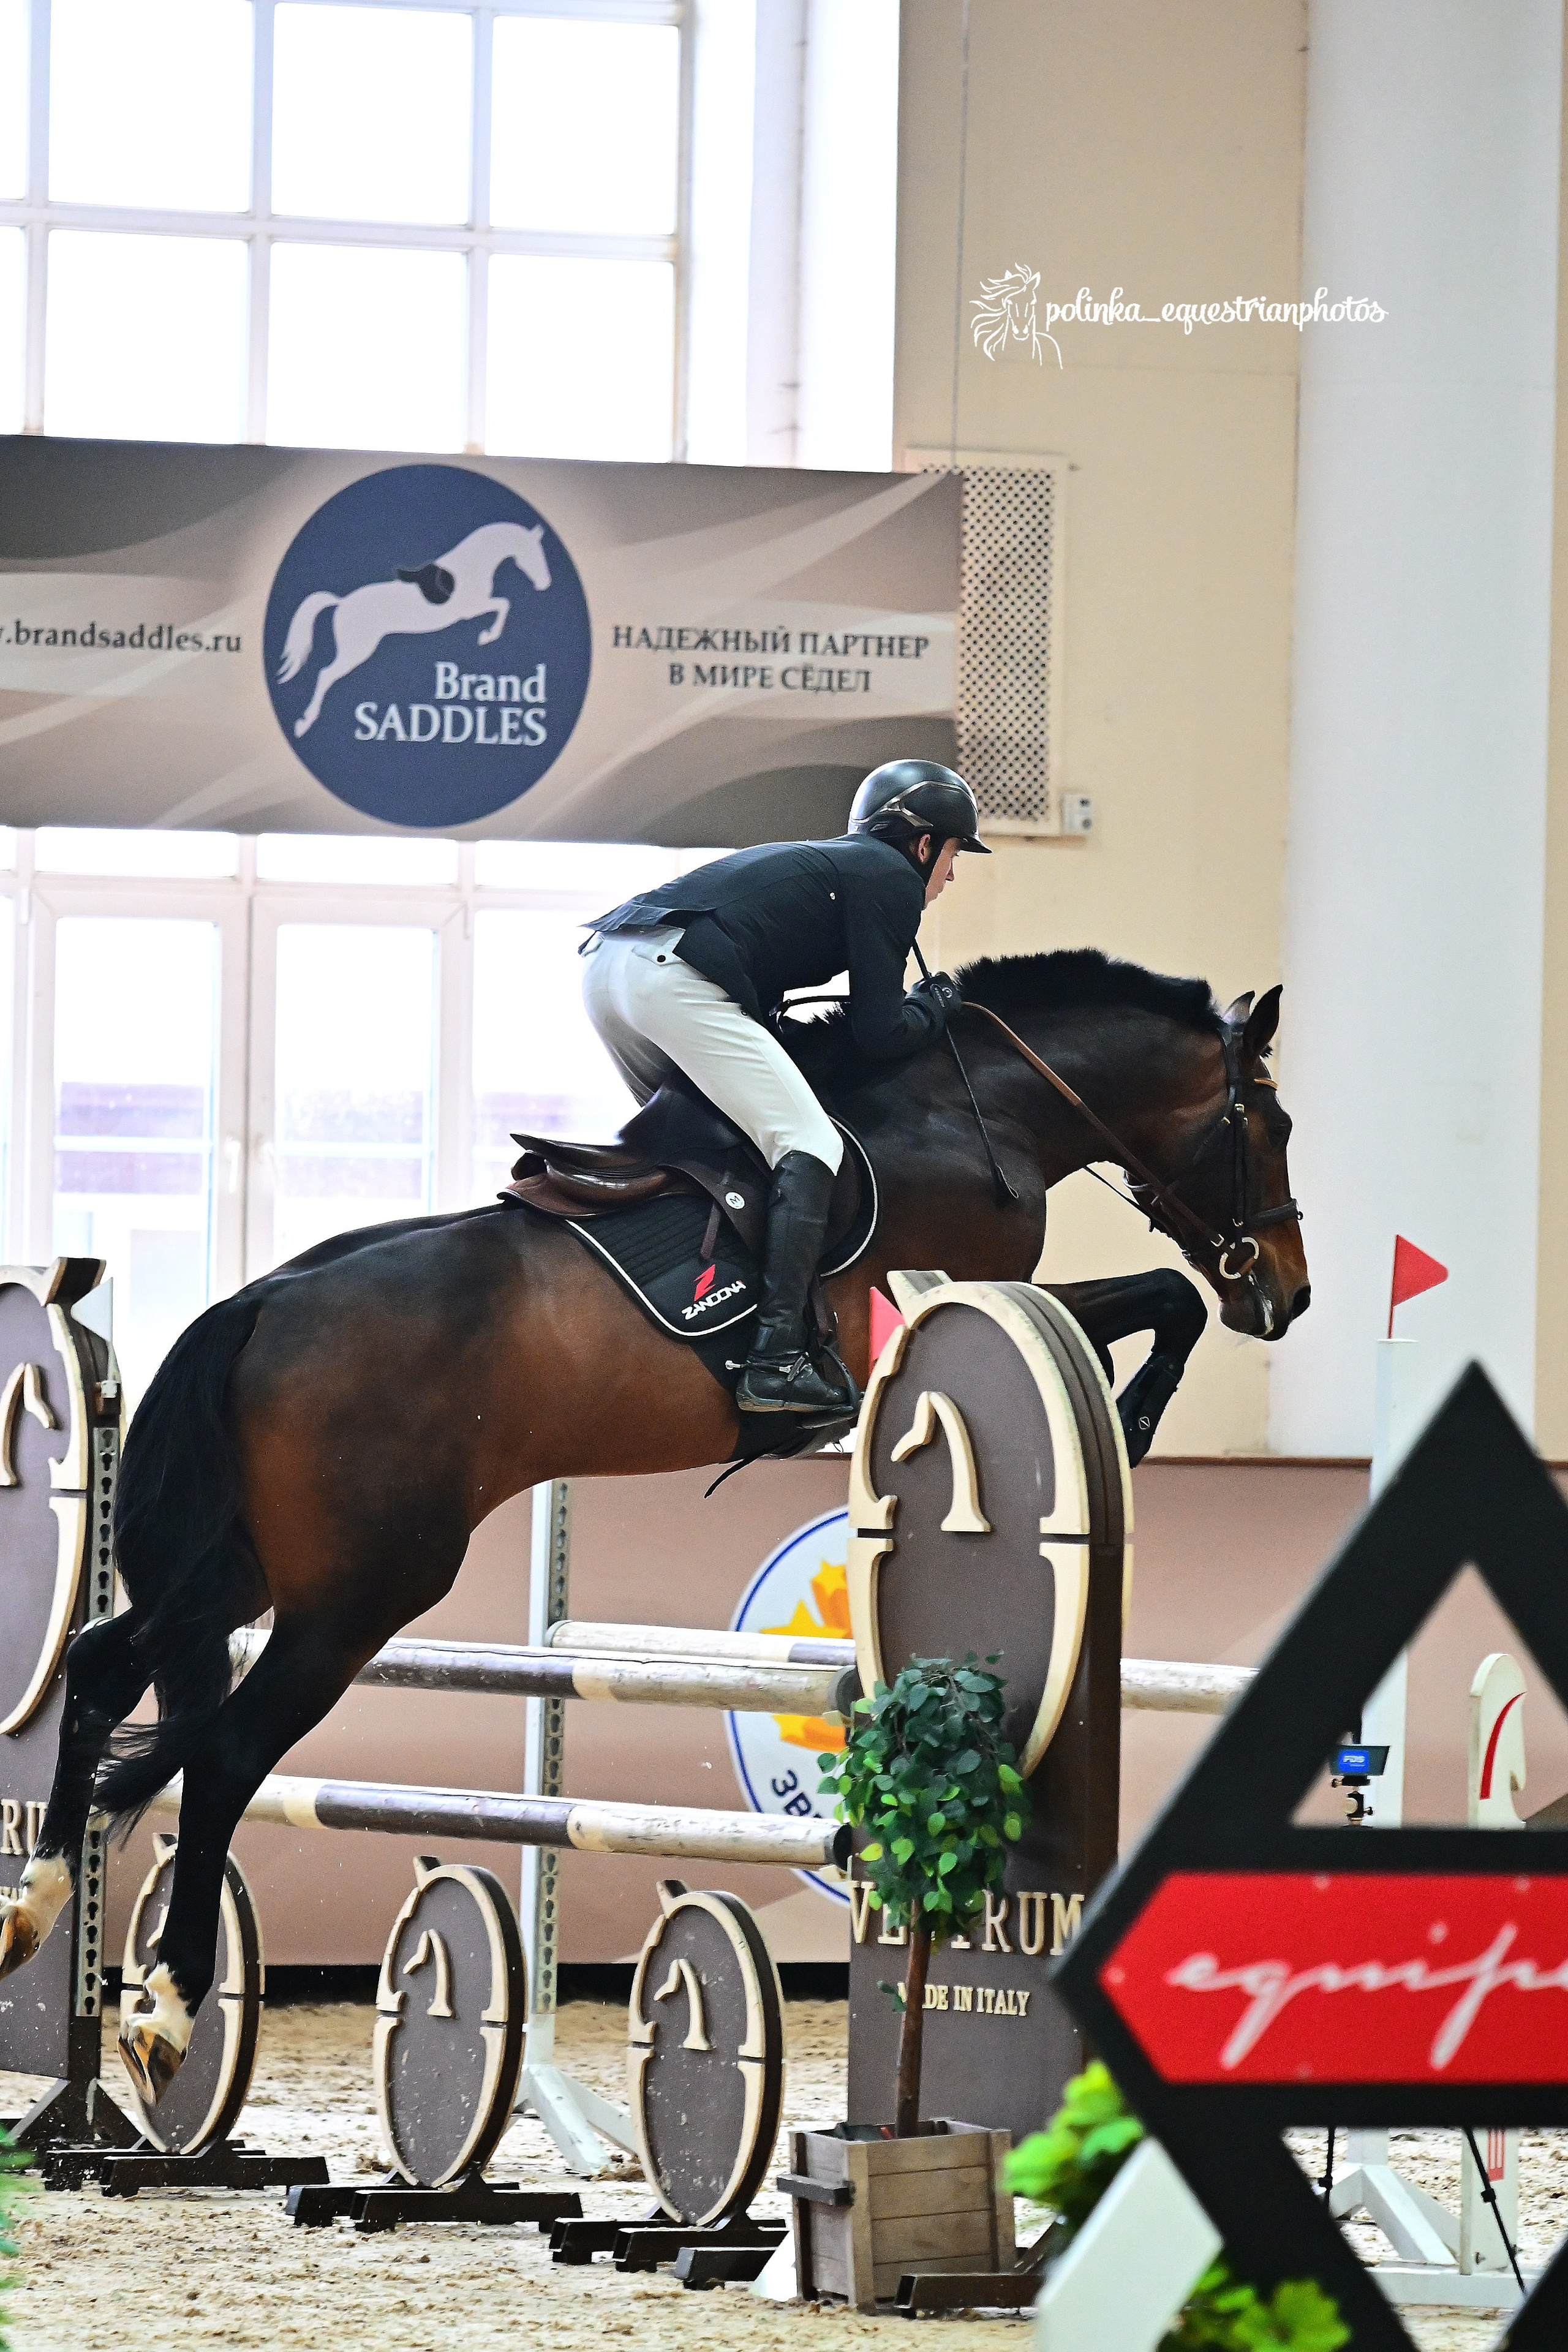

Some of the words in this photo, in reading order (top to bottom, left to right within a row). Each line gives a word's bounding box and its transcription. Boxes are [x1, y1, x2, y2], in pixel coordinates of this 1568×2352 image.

[0, 619, 241, 652] .brandsaddles.ru
[612, 625, 791, 653] НАДЕЖНЫЙ
[799, 632, 929, 659] ПАРТНЕР
[435, 661, 547, 703] Brand
[669, 663, 685, 686] В
[693, 665, 774, 690] МИРЕ
[354, 701, 548, 746] SADDLES
[849, 1880, 1085, 1956] VERUM
[953, 1985, 973, 2013] IN
[976, 1988, 1030, 2016] ITALY
